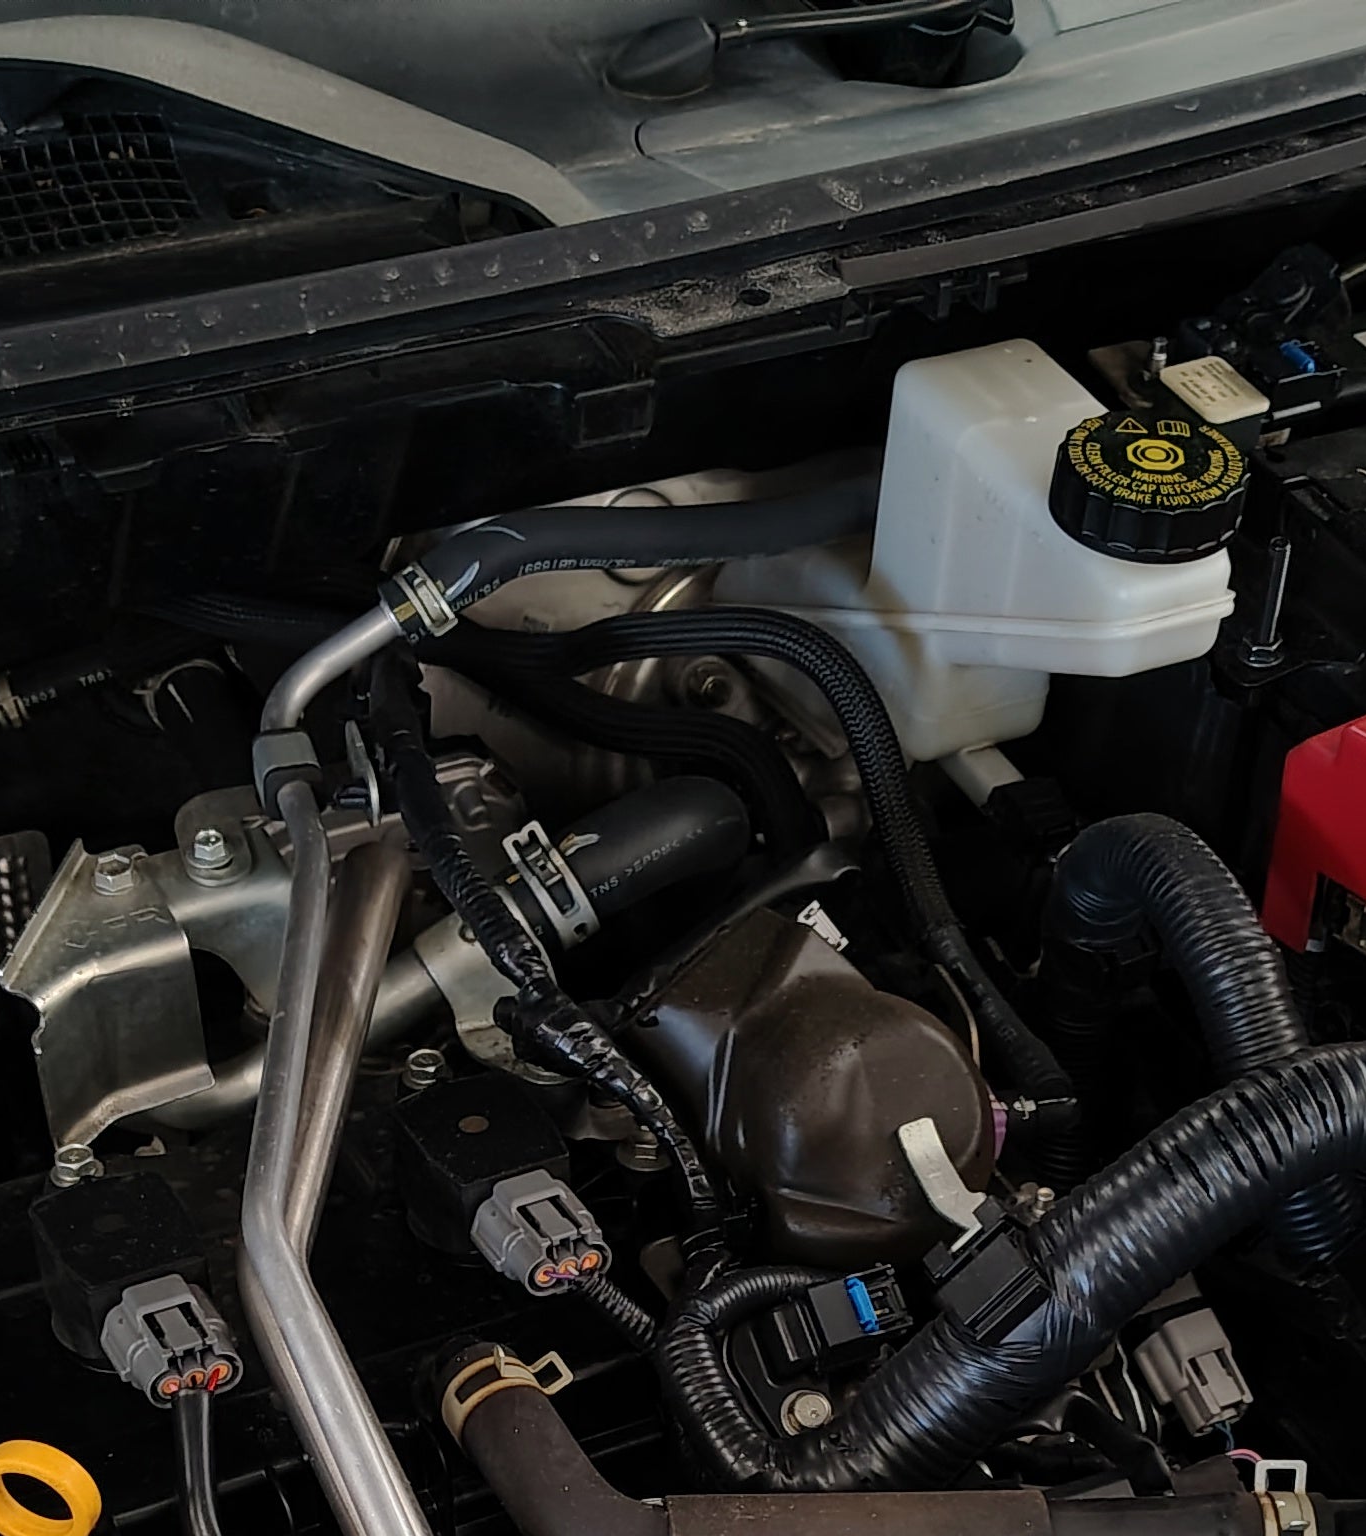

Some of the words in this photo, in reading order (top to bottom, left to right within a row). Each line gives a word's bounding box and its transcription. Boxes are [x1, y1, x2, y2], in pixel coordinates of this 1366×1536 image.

[1086, 442, 1104, 465] CLEAN
[1095, 464, 1131, 486] FILLER
[1132, 478, 1156, 493] CAP
[1160, 479, 1206, 495] BEFORE
[1200, 450, 1224, 484] REMOVING
[1131, 470, 1187, 483] WARNING
[1086, 473, 1114, 491] DOT4
[1113, 487, 1152, 504] BRAKE
[1156, 496, 1190, 506] FLUID
[1190, 486, 1223, 503] FROM
